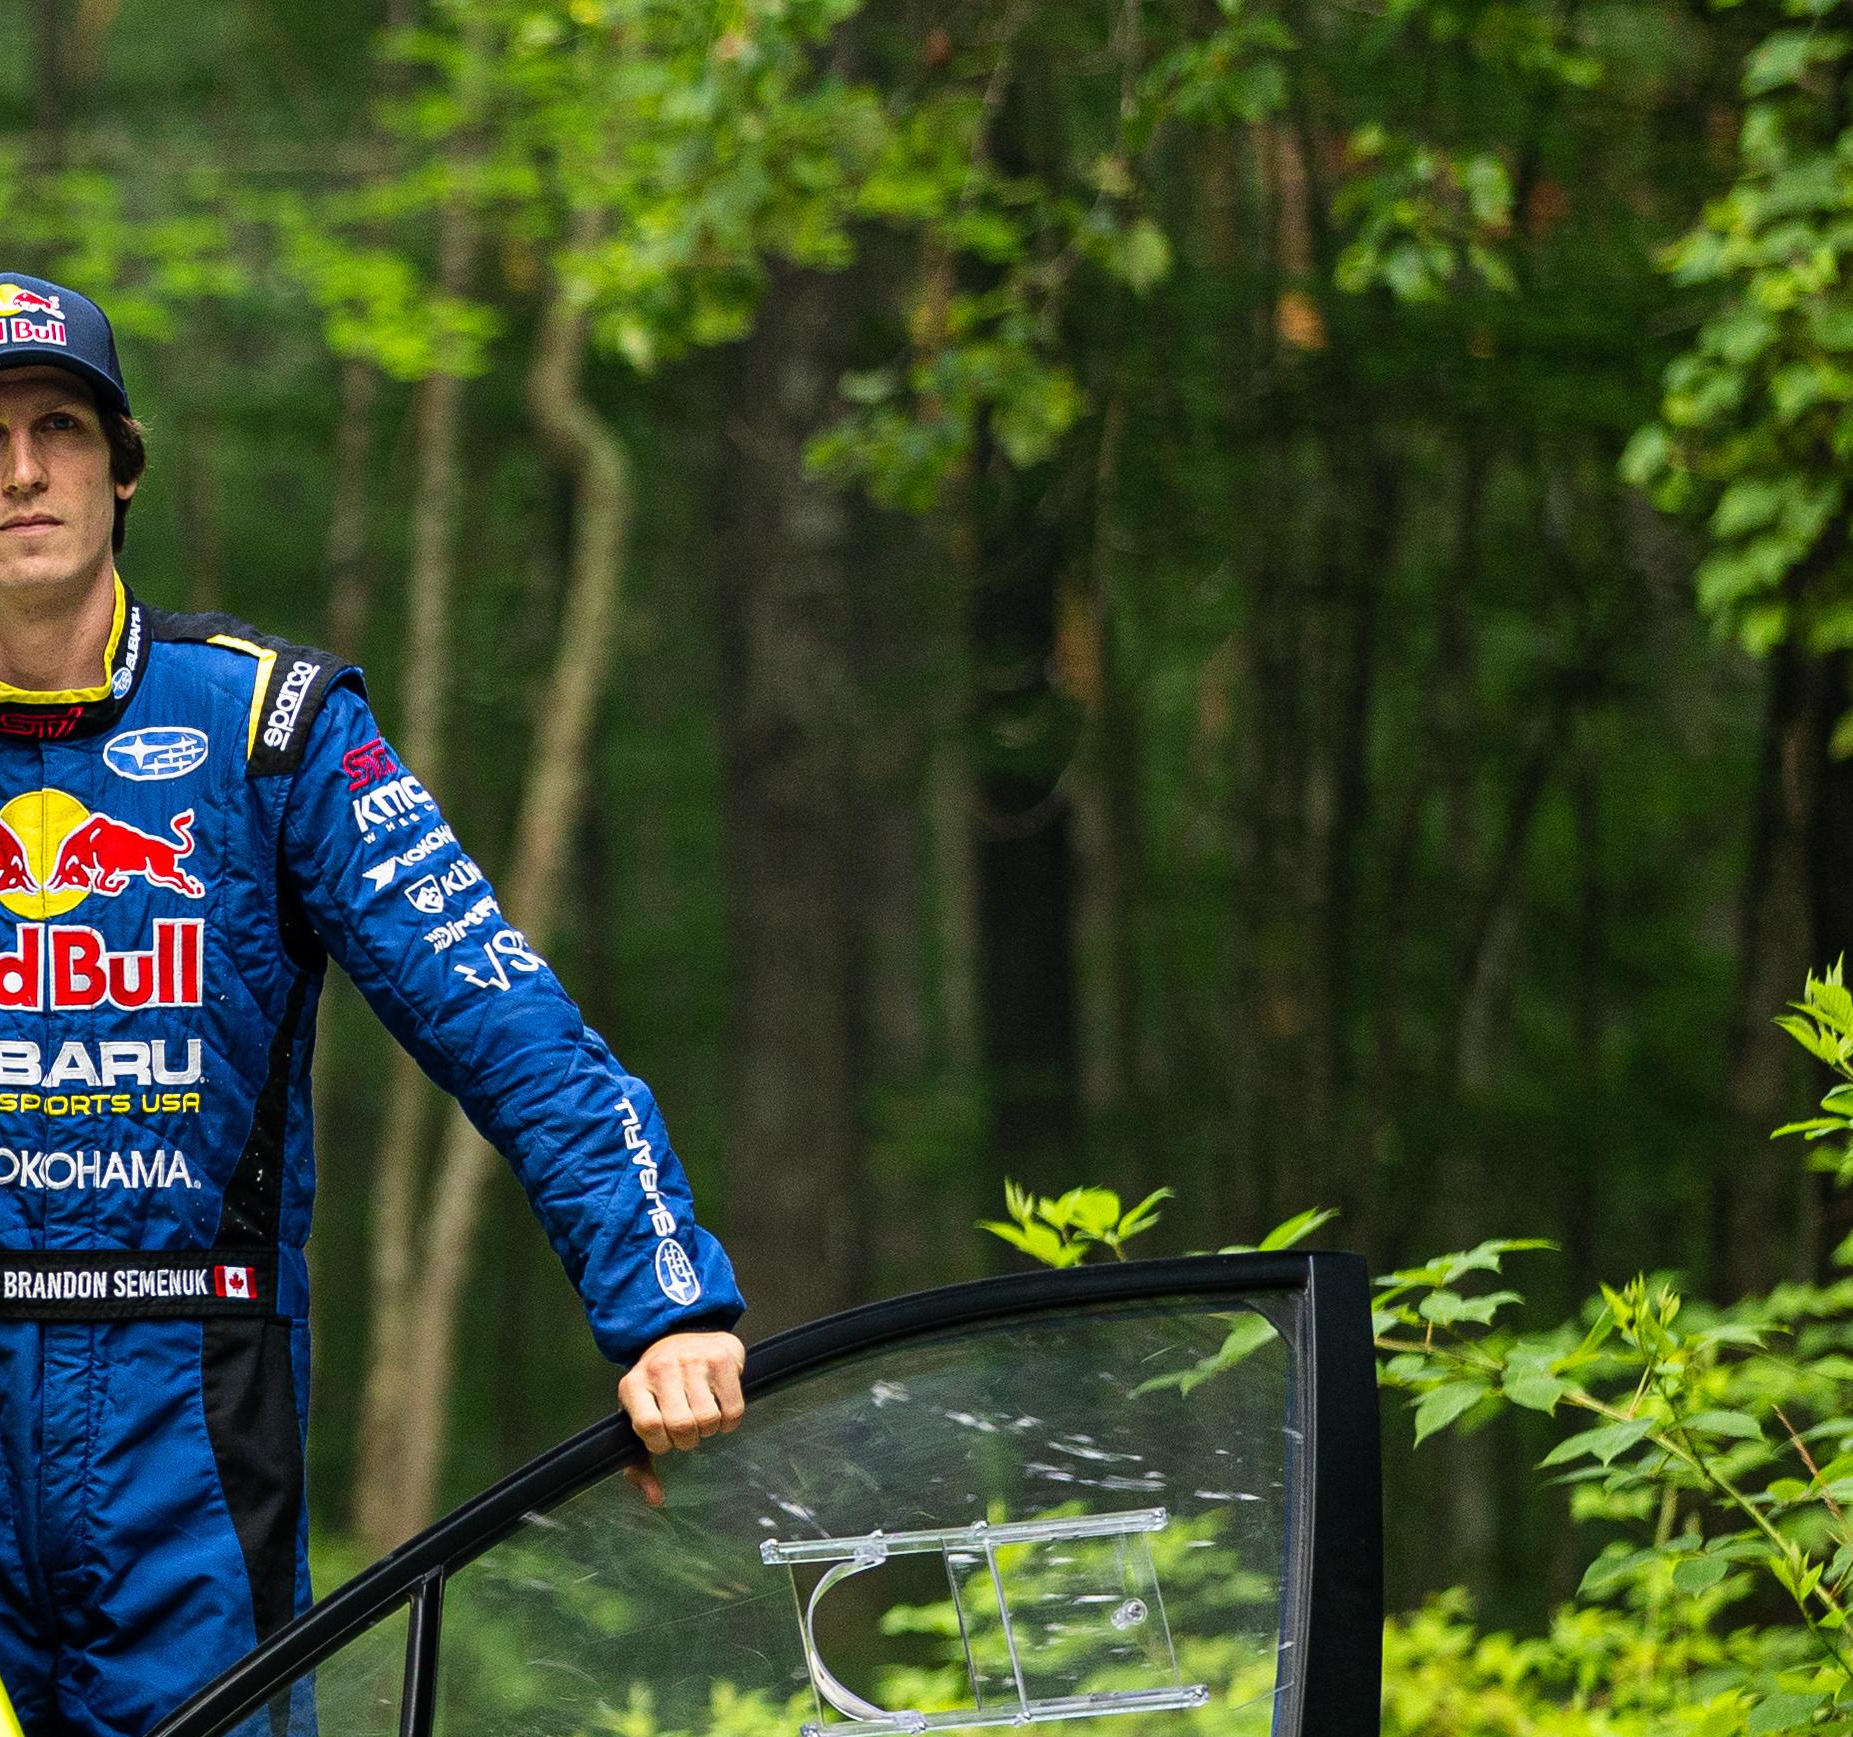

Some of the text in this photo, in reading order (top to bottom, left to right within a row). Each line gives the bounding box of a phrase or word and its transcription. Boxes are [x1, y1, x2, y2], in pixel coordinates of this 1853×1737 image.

[13, 320, 66, 345] Bull
[263, 660, 321, 752] sparco
[52, 923, 199, 1007] Bull
[141, 1092, 200, 1113] USA
[3, 1268, 209, 1299] BRANDON SEMENUK
